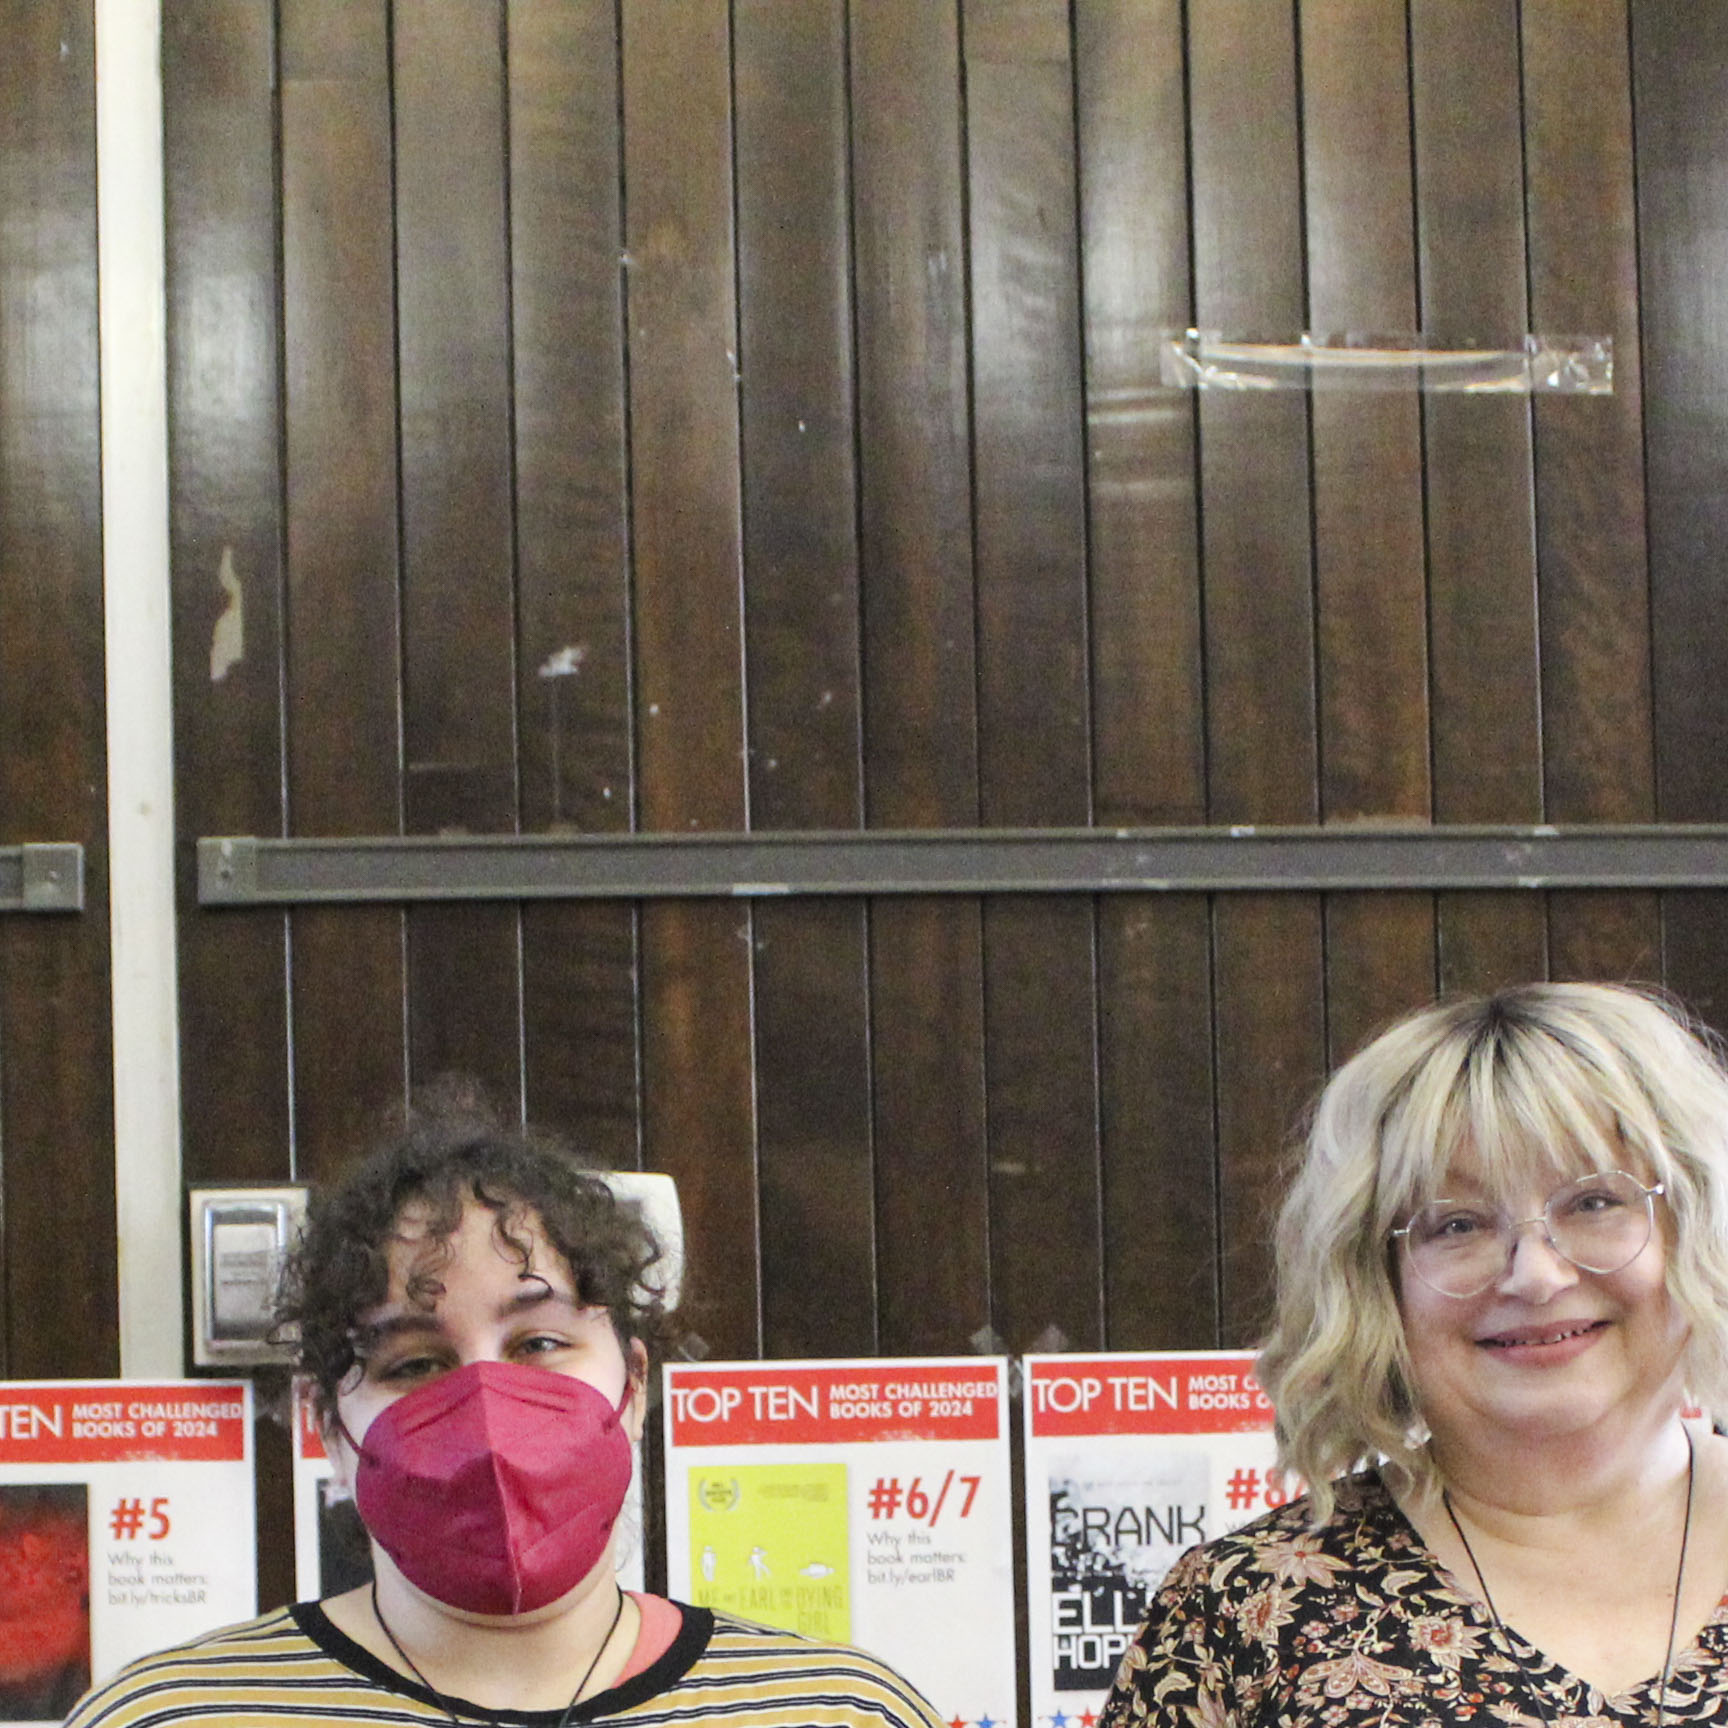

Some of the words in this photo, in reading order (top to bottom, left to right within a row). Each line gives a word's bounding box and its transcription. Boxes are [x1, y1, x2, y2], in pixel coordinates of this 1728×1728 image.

[672, 1387, 742, 1422] TOP
[749, 1385, 818, 1420] TEN
[830, 1384, 879, 1401] MOST
[885, 1381, 998, 1399] CHALLENGED
[830, 1402, 893, 1419] BOOKS
[898, 1402, 922, 1417] OF
[929, 1400, 973, 1417] 2024
[868, 1469, 982, 1528] #6/7
[109, 1497, 172, 1542] #5
[1052, 1505, 1206, 1548] CRANK
[867, 1532, 902, 1550] Why
[907, 1532, 931, 1545] this
[867, 1550, 903, 1564] book
